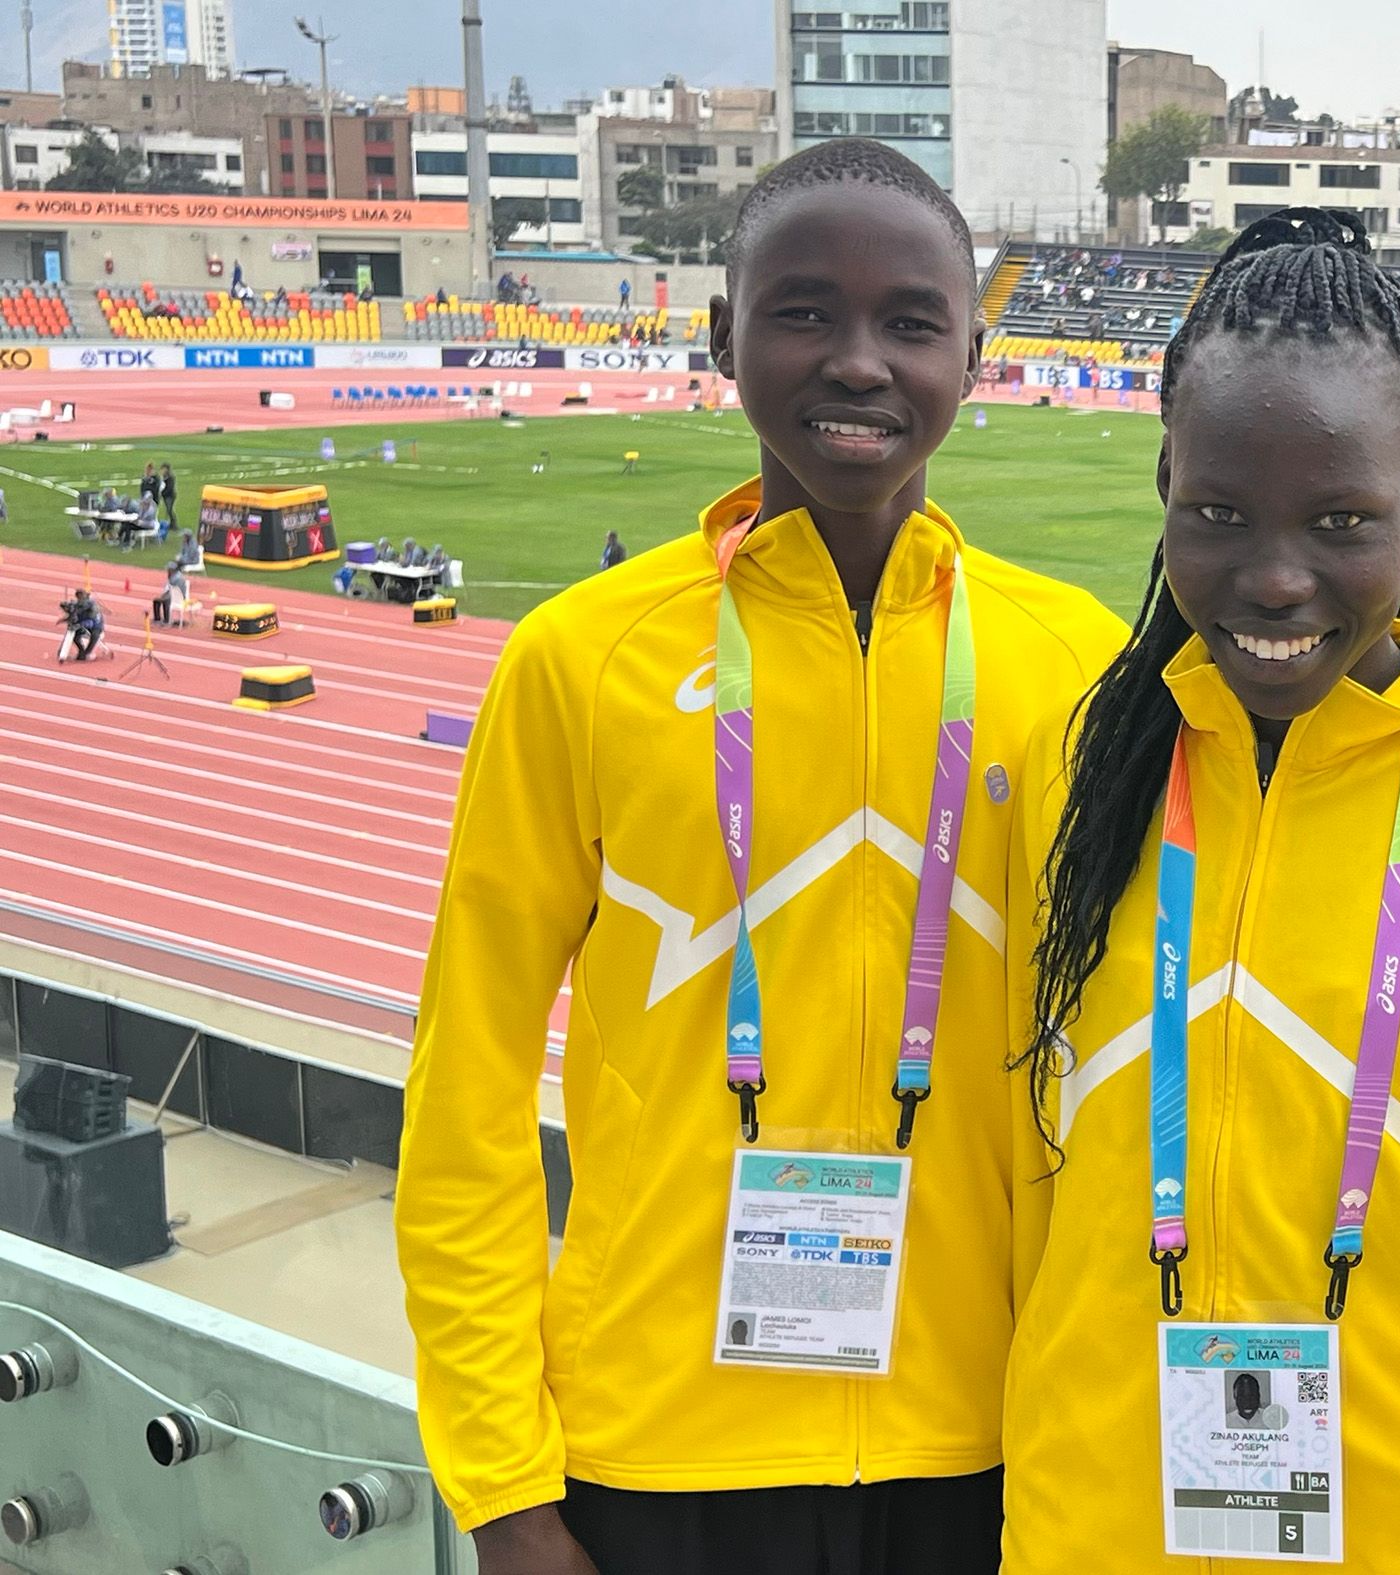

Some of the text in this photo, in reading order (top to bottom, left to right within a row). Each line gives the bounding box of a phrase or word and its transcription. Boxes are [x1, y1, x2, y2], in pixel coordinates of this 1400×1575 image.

[35, 200, 412, 222] WORLD ATHLETICS U20 CHAMPIONSHIPS LIMA 24
[98, 350, 155, 366] TDK
[195, 349, 304, 367] NTN NTN
[489, 349, 536, 368] asics
[580, 351, 675, 369] SONY
[730, 803, 742, 839] asics
[938, 809, 953, 844] asics
[1384, 955, 1399, 995] asics
[1164, 963, 1177, 1000] asics
[820, 1175, 851, 1188] LIMA
[855, 1178, 872, 1189] 24
[754, 1234, 776, 1242] asics
[800, 1236, 826, 1246] NTN
[844, 1238, 892, 1250] SEIKO
[737, 1248, 779, 1257] SONY
[802, 1250, 833, 1261] TDK
[854, 1252, 880, 1264] TBS
[1247, 1350, 1300, 1360] LIMA 24
[1310, 1408, 1328, 1416] ART
[1210, 1432, 1289, 1442] ZINAD AKULANG
[1232, 1442, 1269, 1452] JOSEPH
[1311, 1477, 1328, 1488] BA
[1225, 1495, 1279, 1507] ATHLETE
[1286, 1526, 1297, 1541] 5
